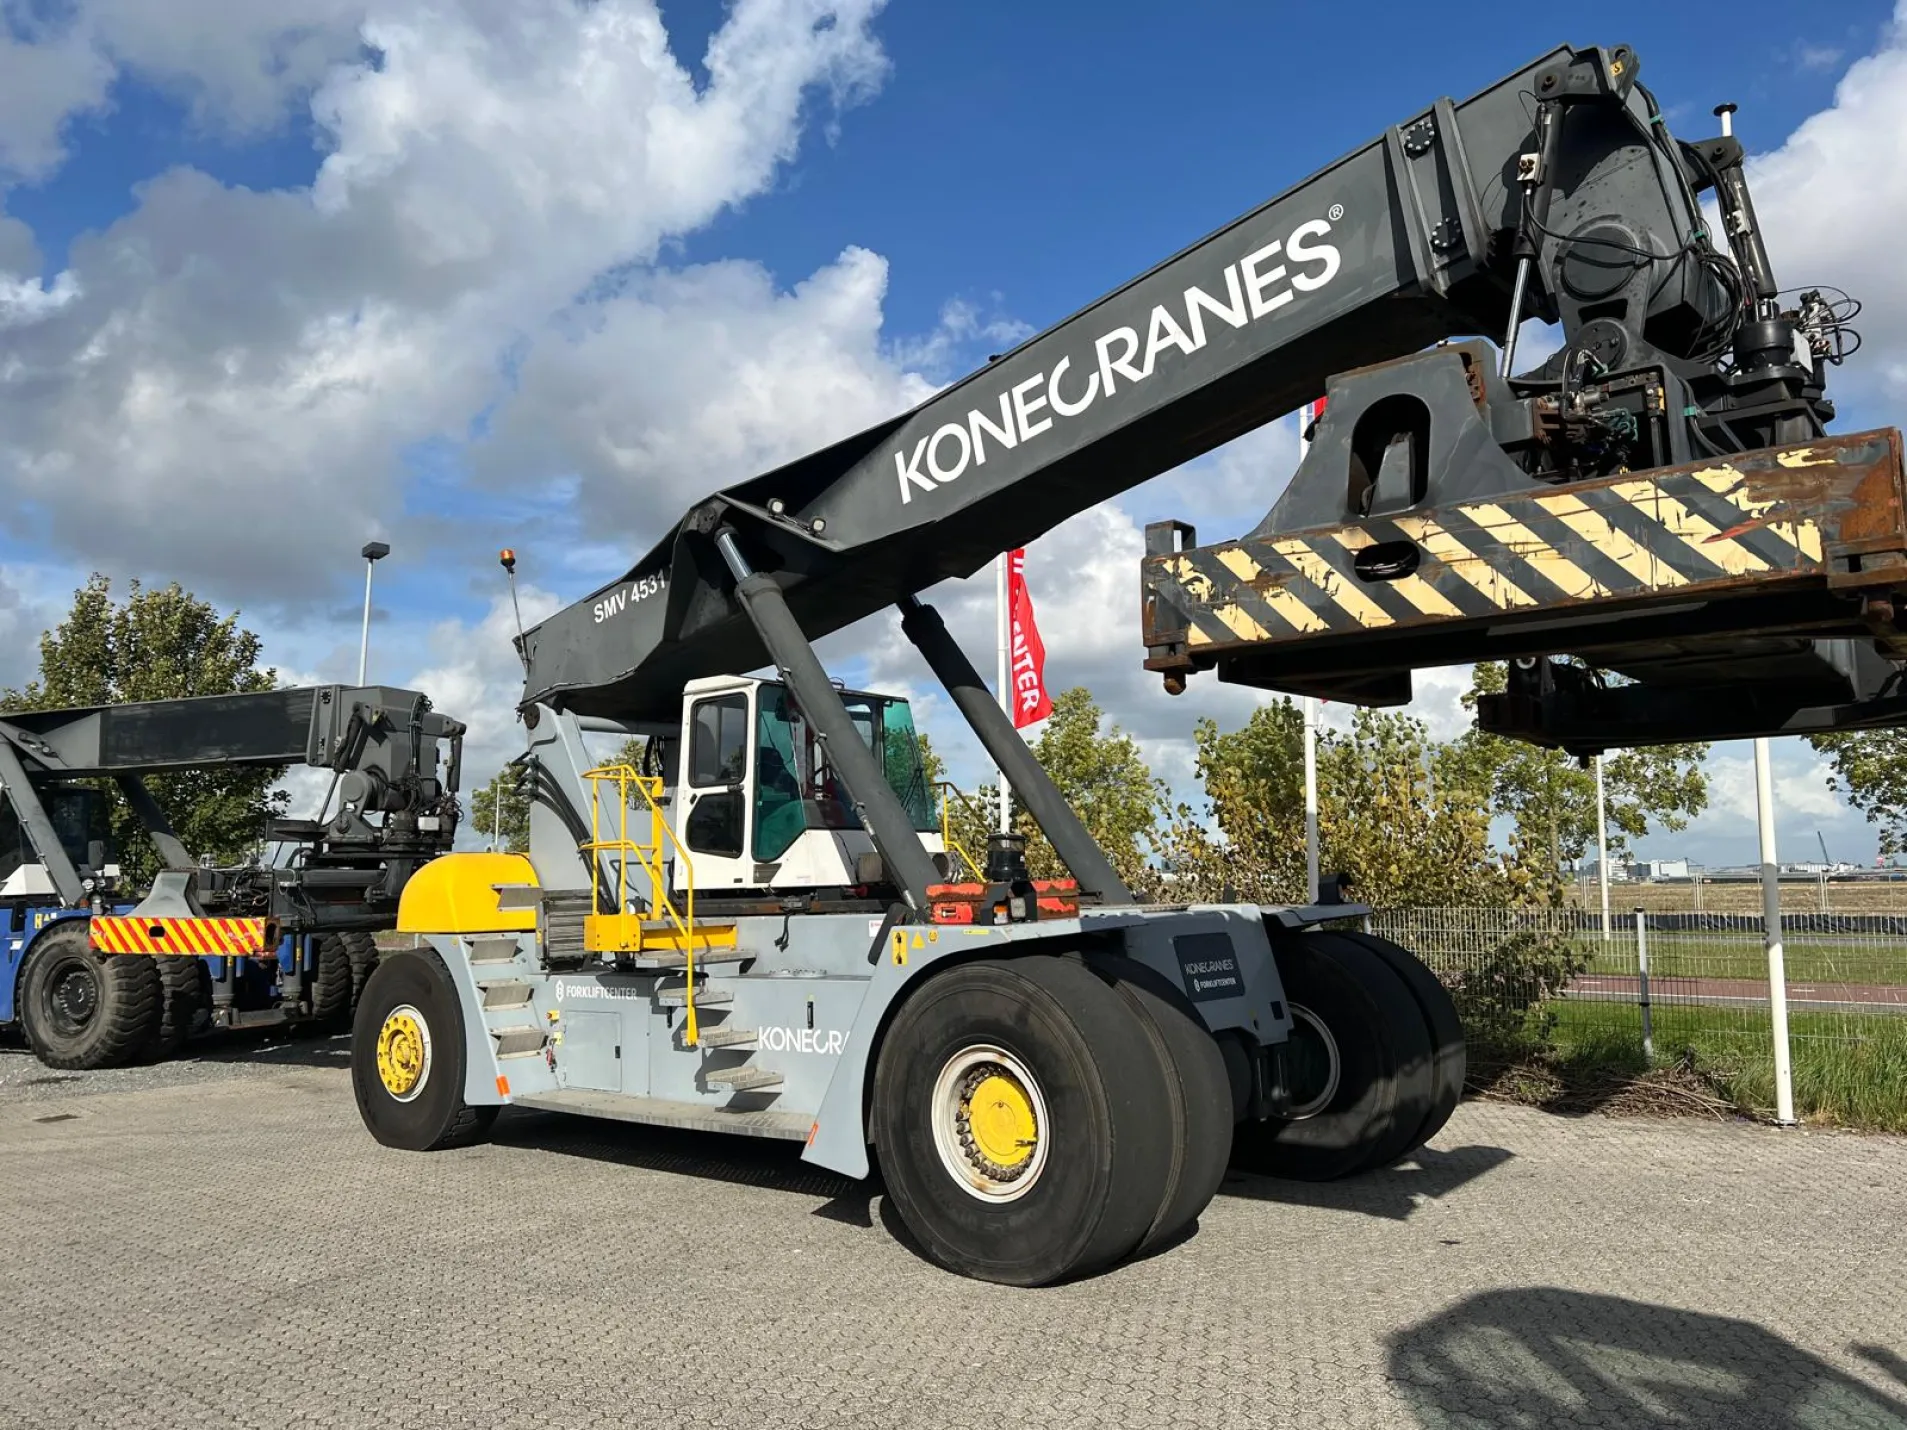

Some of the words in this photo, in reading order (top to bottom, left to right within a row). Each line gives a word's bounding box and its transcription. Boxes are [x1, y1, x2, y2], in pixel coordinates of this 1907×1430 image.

[593, 589, 627, 623] SMV
[631, 568, 666, 602] 4531
[565, 984, 638, 1001] FORKLIFTCENTER
